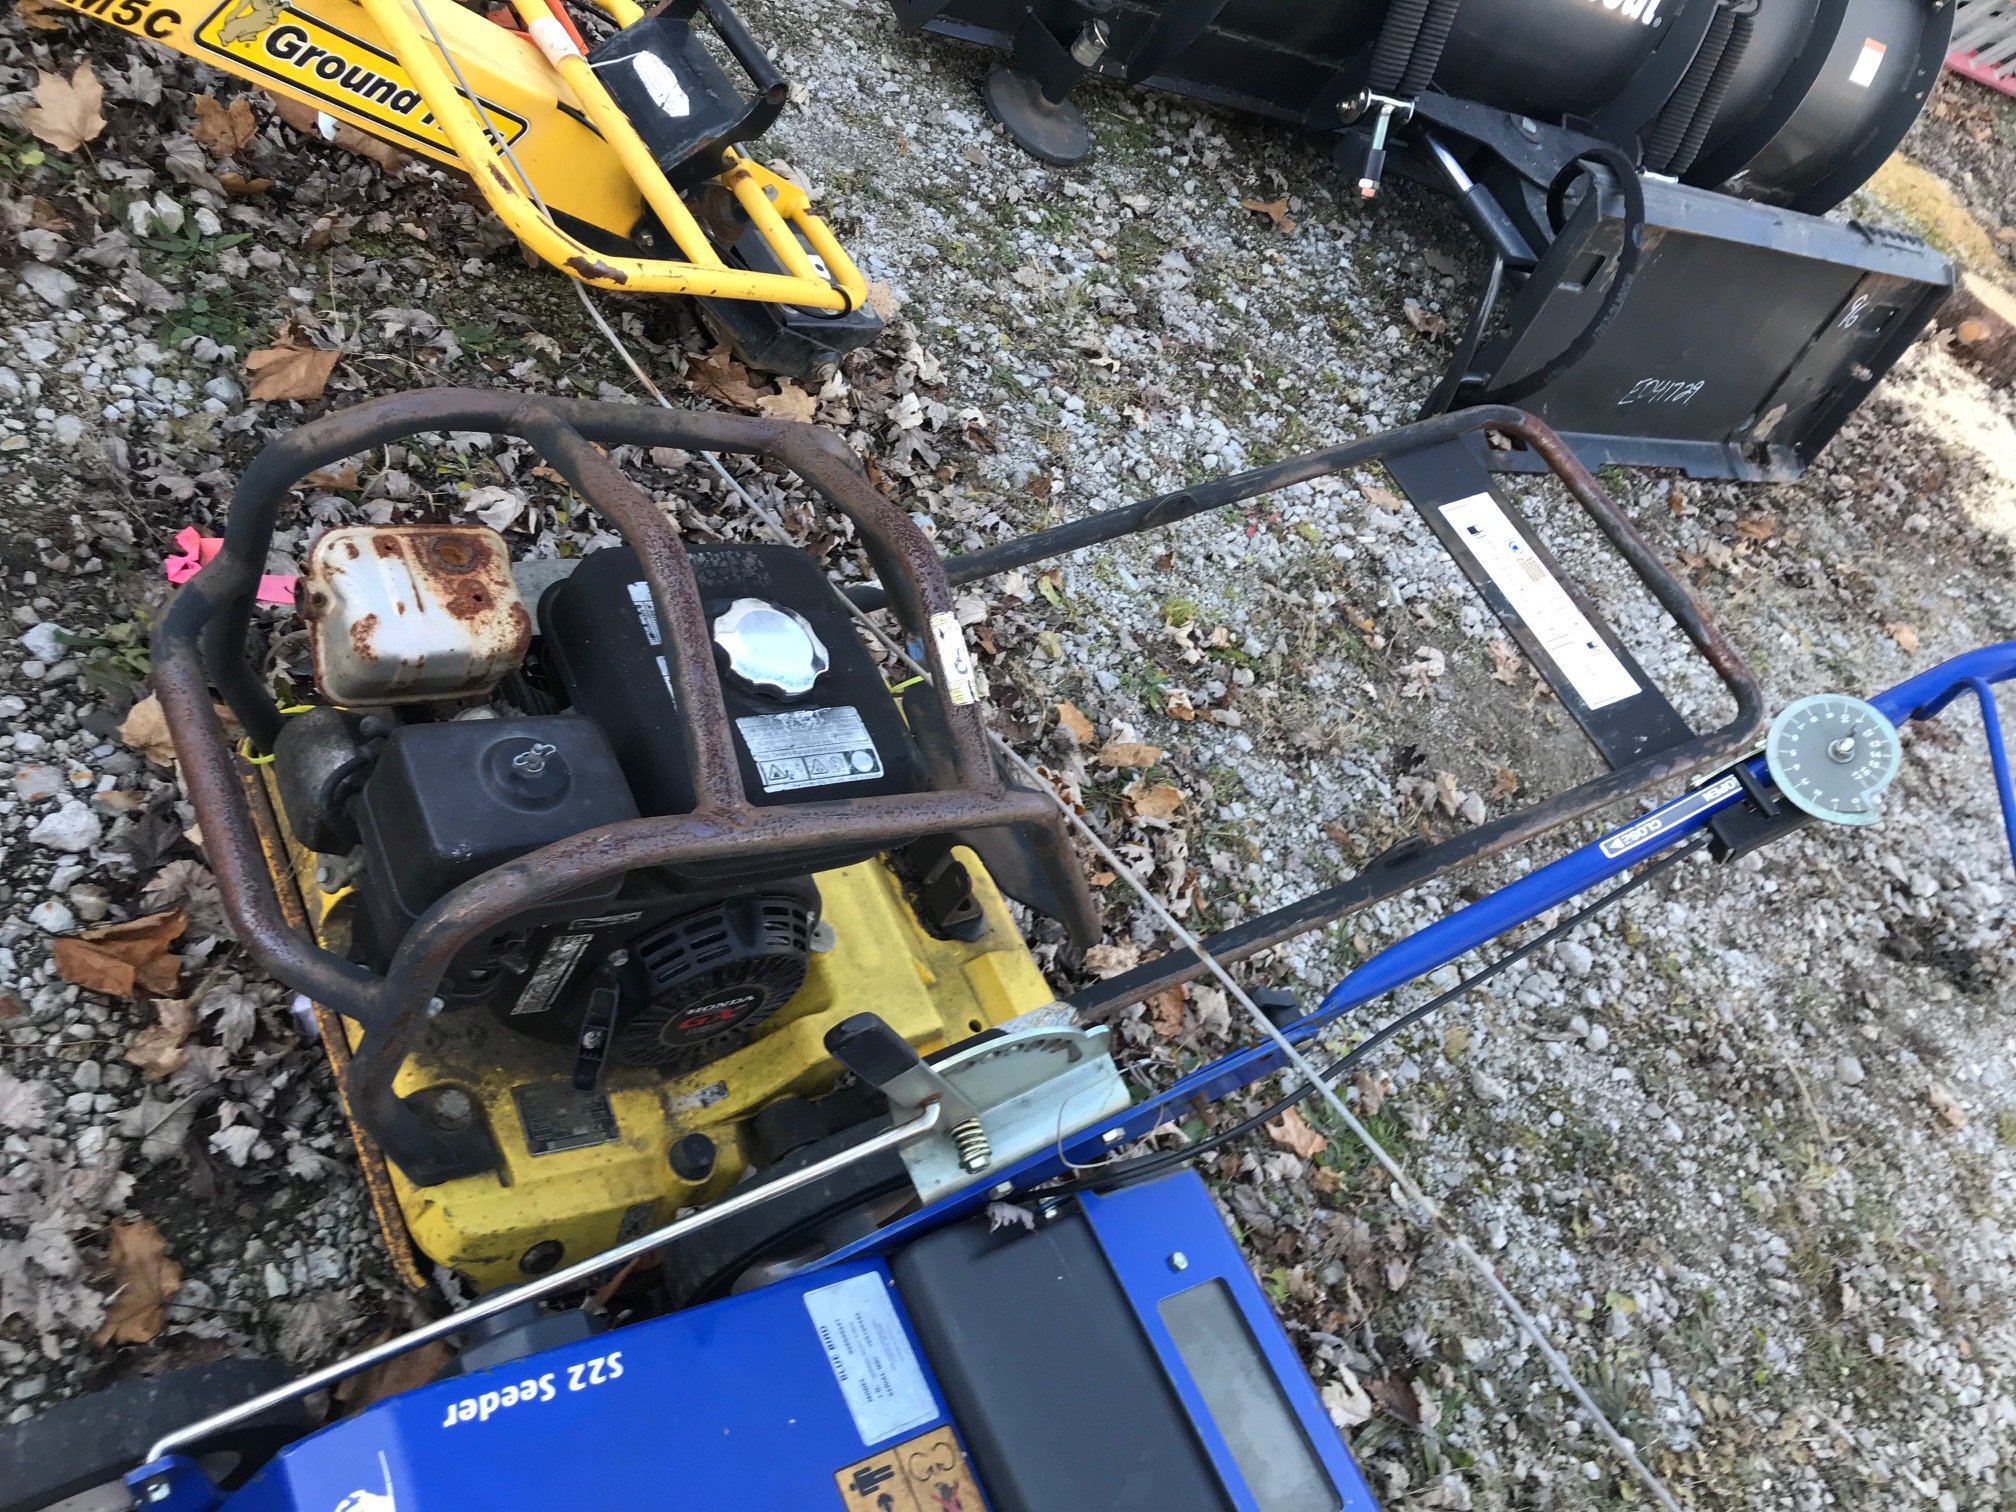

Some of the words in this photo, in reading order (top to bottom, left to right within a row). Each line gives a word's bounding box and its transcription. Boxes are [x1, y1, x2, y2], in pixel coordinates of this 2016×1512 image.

[264, 24, 423, 115] Ground
[1622, 819, 1663, 846] CLOSE
[685, 994, 755, 1016] HONDA
[820, 1325, 835, 1351] BIRD
[567, 1351, 625, 1392] S22
[832, 1354, 848, 1381] BLUE
[442, 1373, 557, 1428] Seeder
